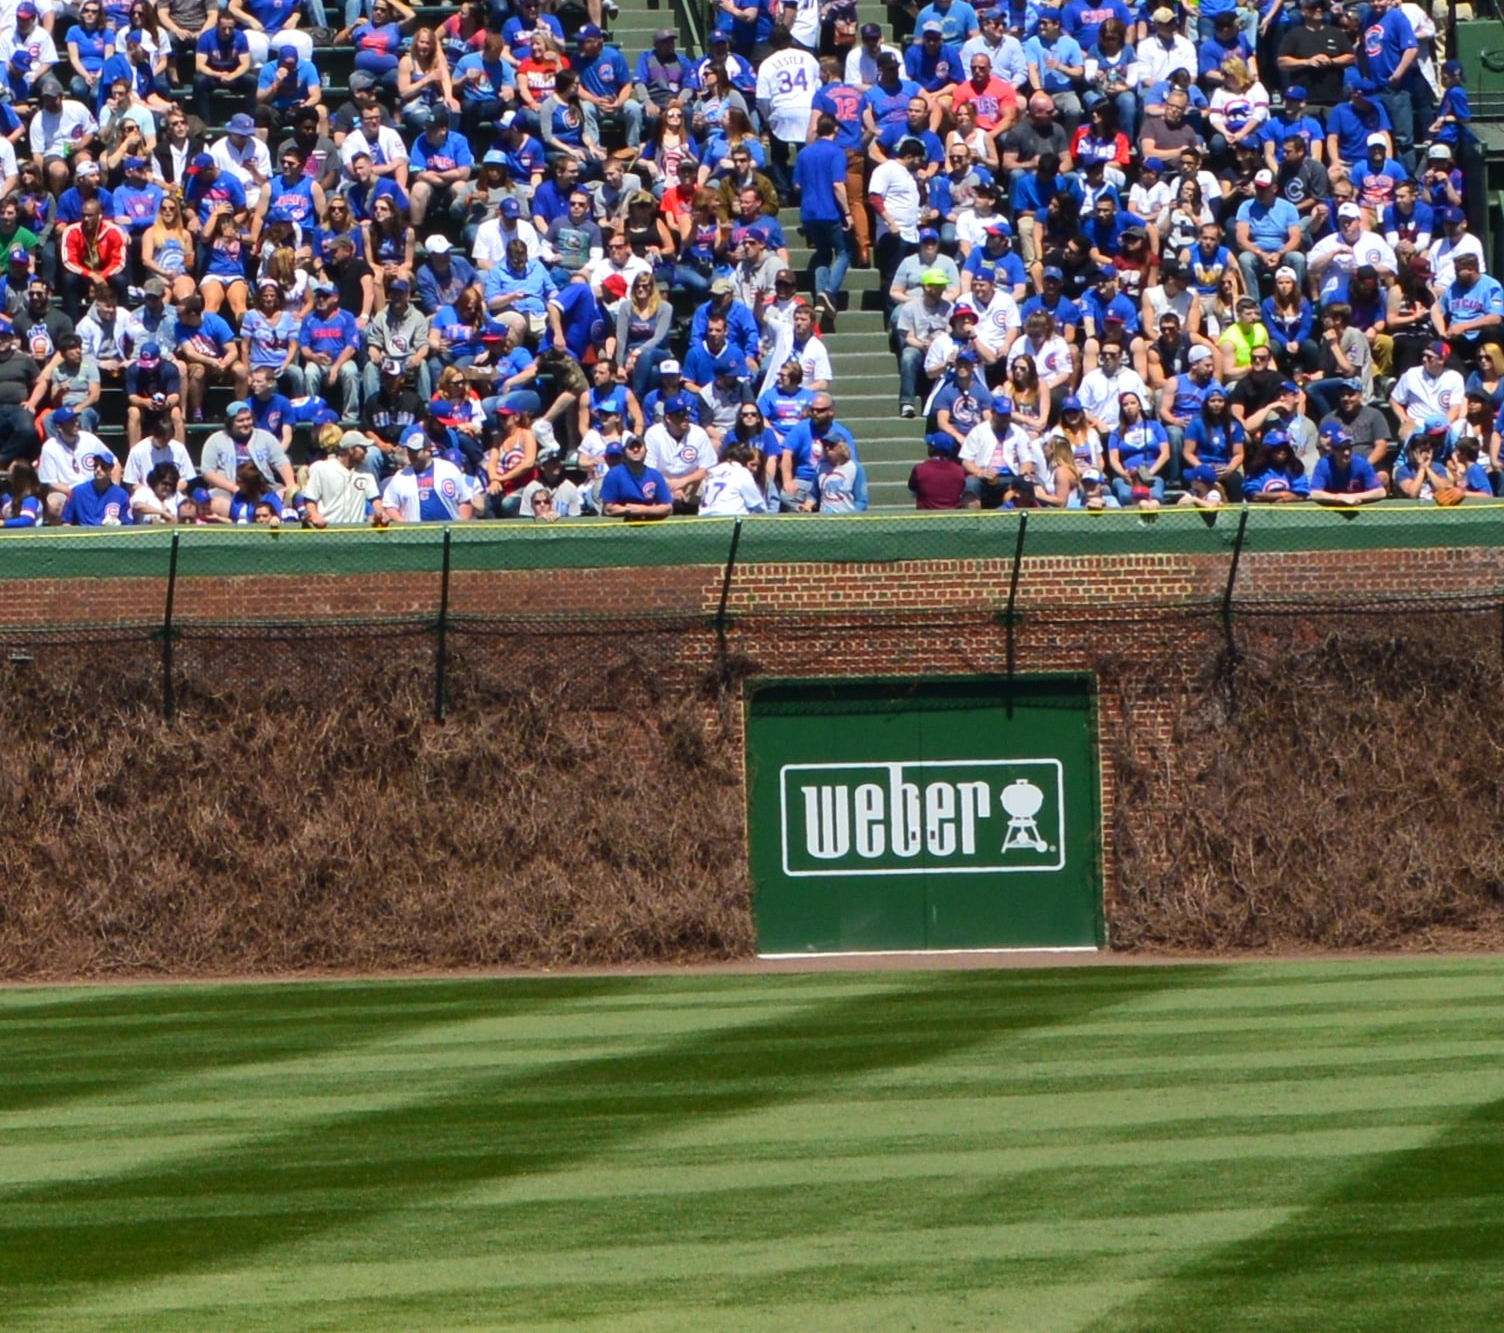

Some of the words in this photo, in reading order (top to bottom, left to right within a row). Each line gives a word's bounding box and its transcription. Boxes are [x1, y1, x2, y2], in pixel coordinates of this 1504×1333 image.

[772, 55, 806, 71] LESTER
[776, 67, 809, 95] 34
[835, 96, 858, 121] 12
[800, 765, 991, 860] weber
